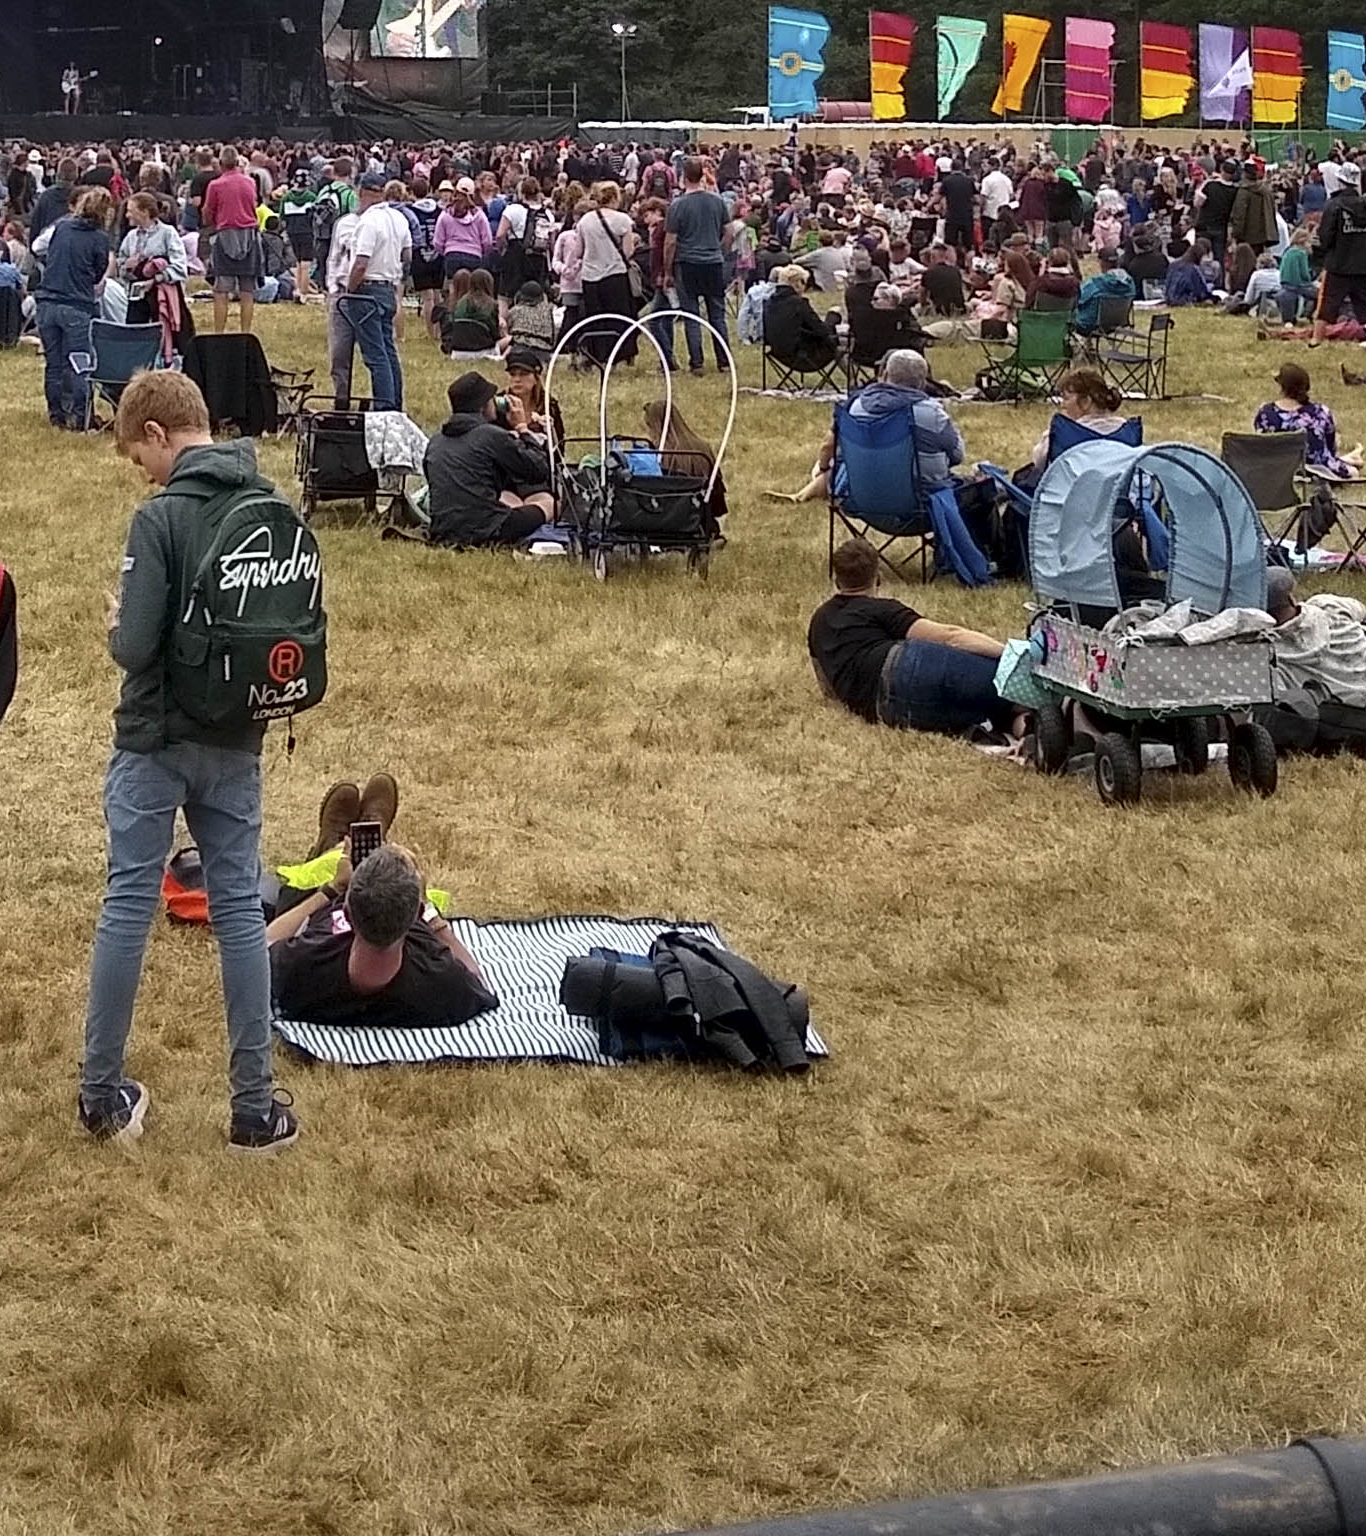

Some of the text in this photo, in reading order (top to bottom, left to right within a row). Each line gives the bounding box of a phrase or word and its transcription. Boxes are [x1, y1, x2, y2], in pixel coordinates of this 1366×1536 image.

[219, 526, 322, 617] Superdry
[247, 677, 309, 708] No.23
[252, 704, 295, 720] LONDON
